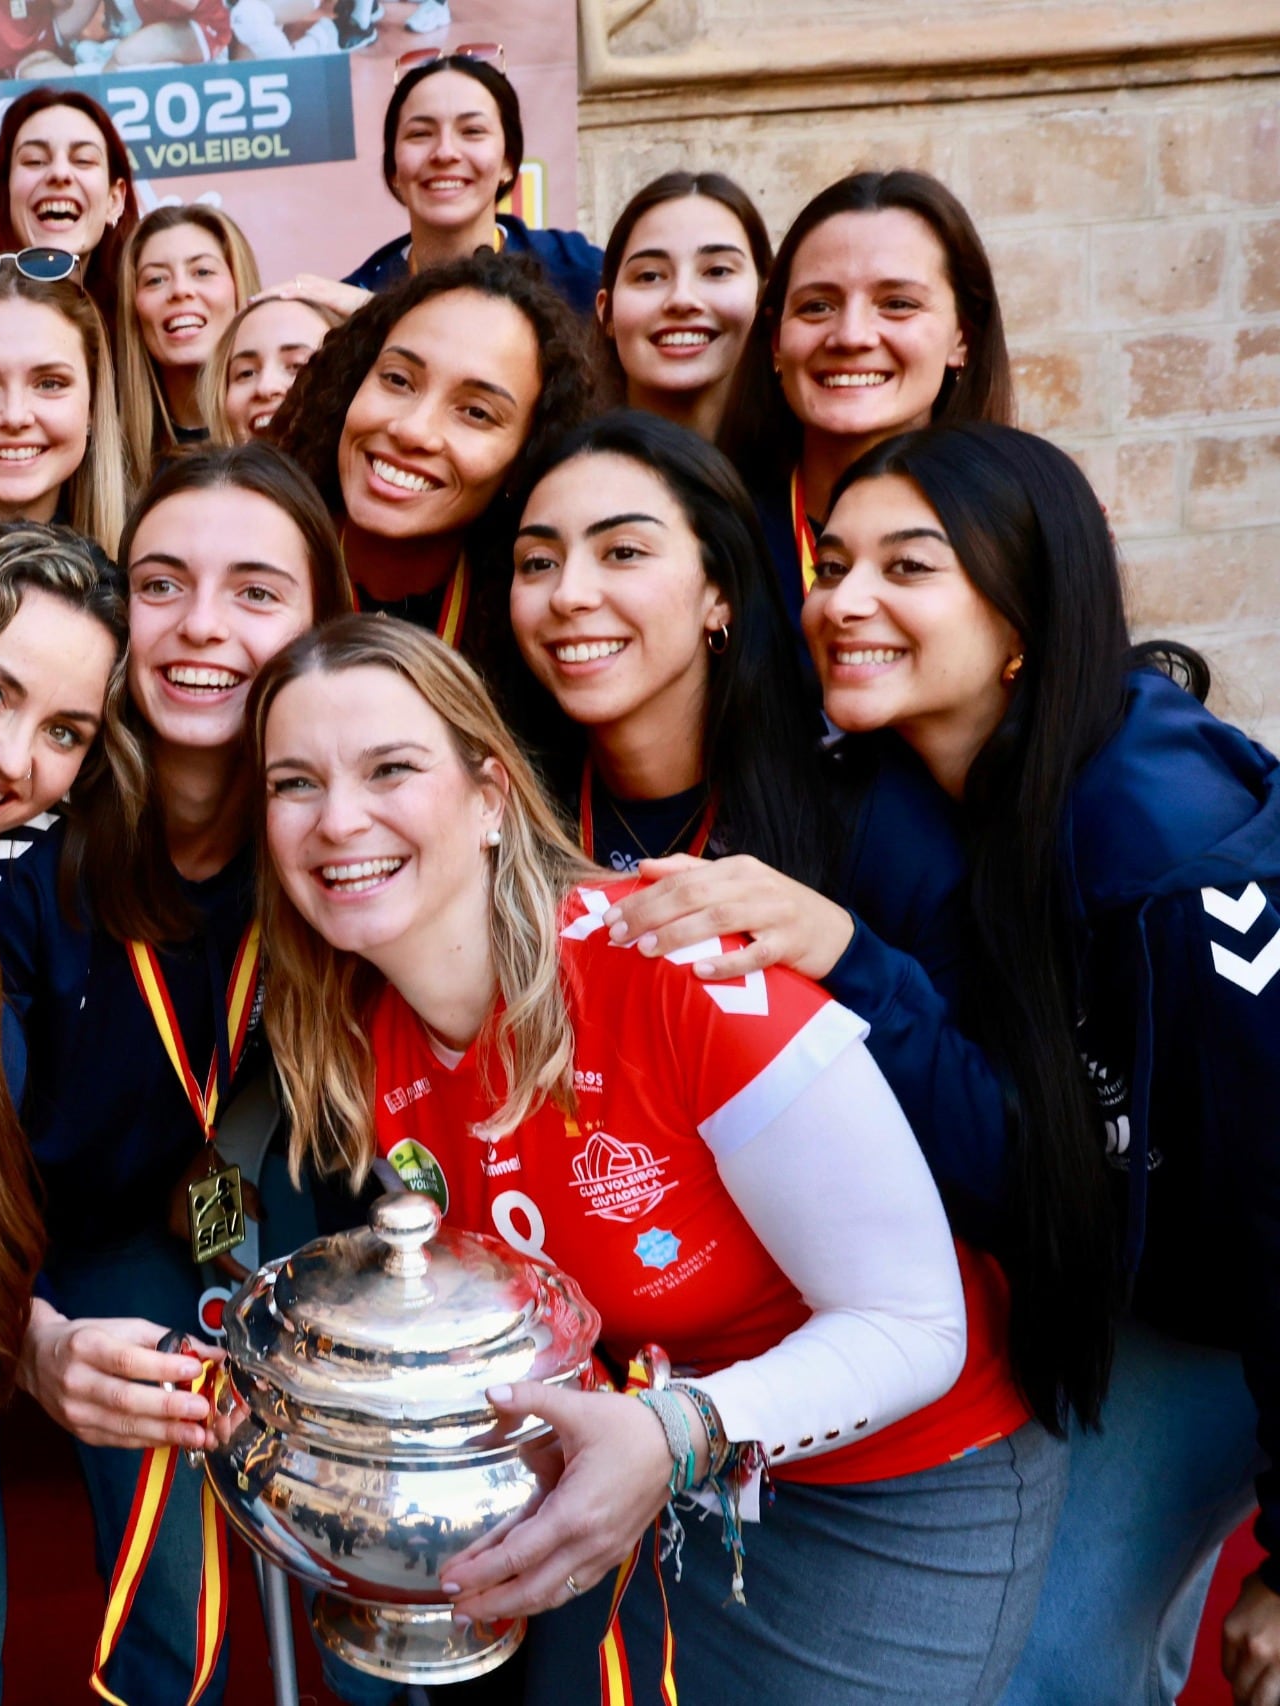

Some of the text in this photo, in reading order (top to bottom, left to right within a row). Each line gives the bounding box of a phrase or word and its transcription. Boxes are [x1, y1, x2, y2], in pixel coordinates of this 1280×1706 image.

[106, 72, 293, 143] 2025
[144, 133, 290, 170] VOLEIBOL
[579, 1166, 666, 1198] CLUB VOLEIBOL
[591, 1179, 662, 1209] CIUTADELLA
[632, 1239, 718, 1297] CONSELL INSULAR
[650, 1255, 712, 1299] DE MENORCA
